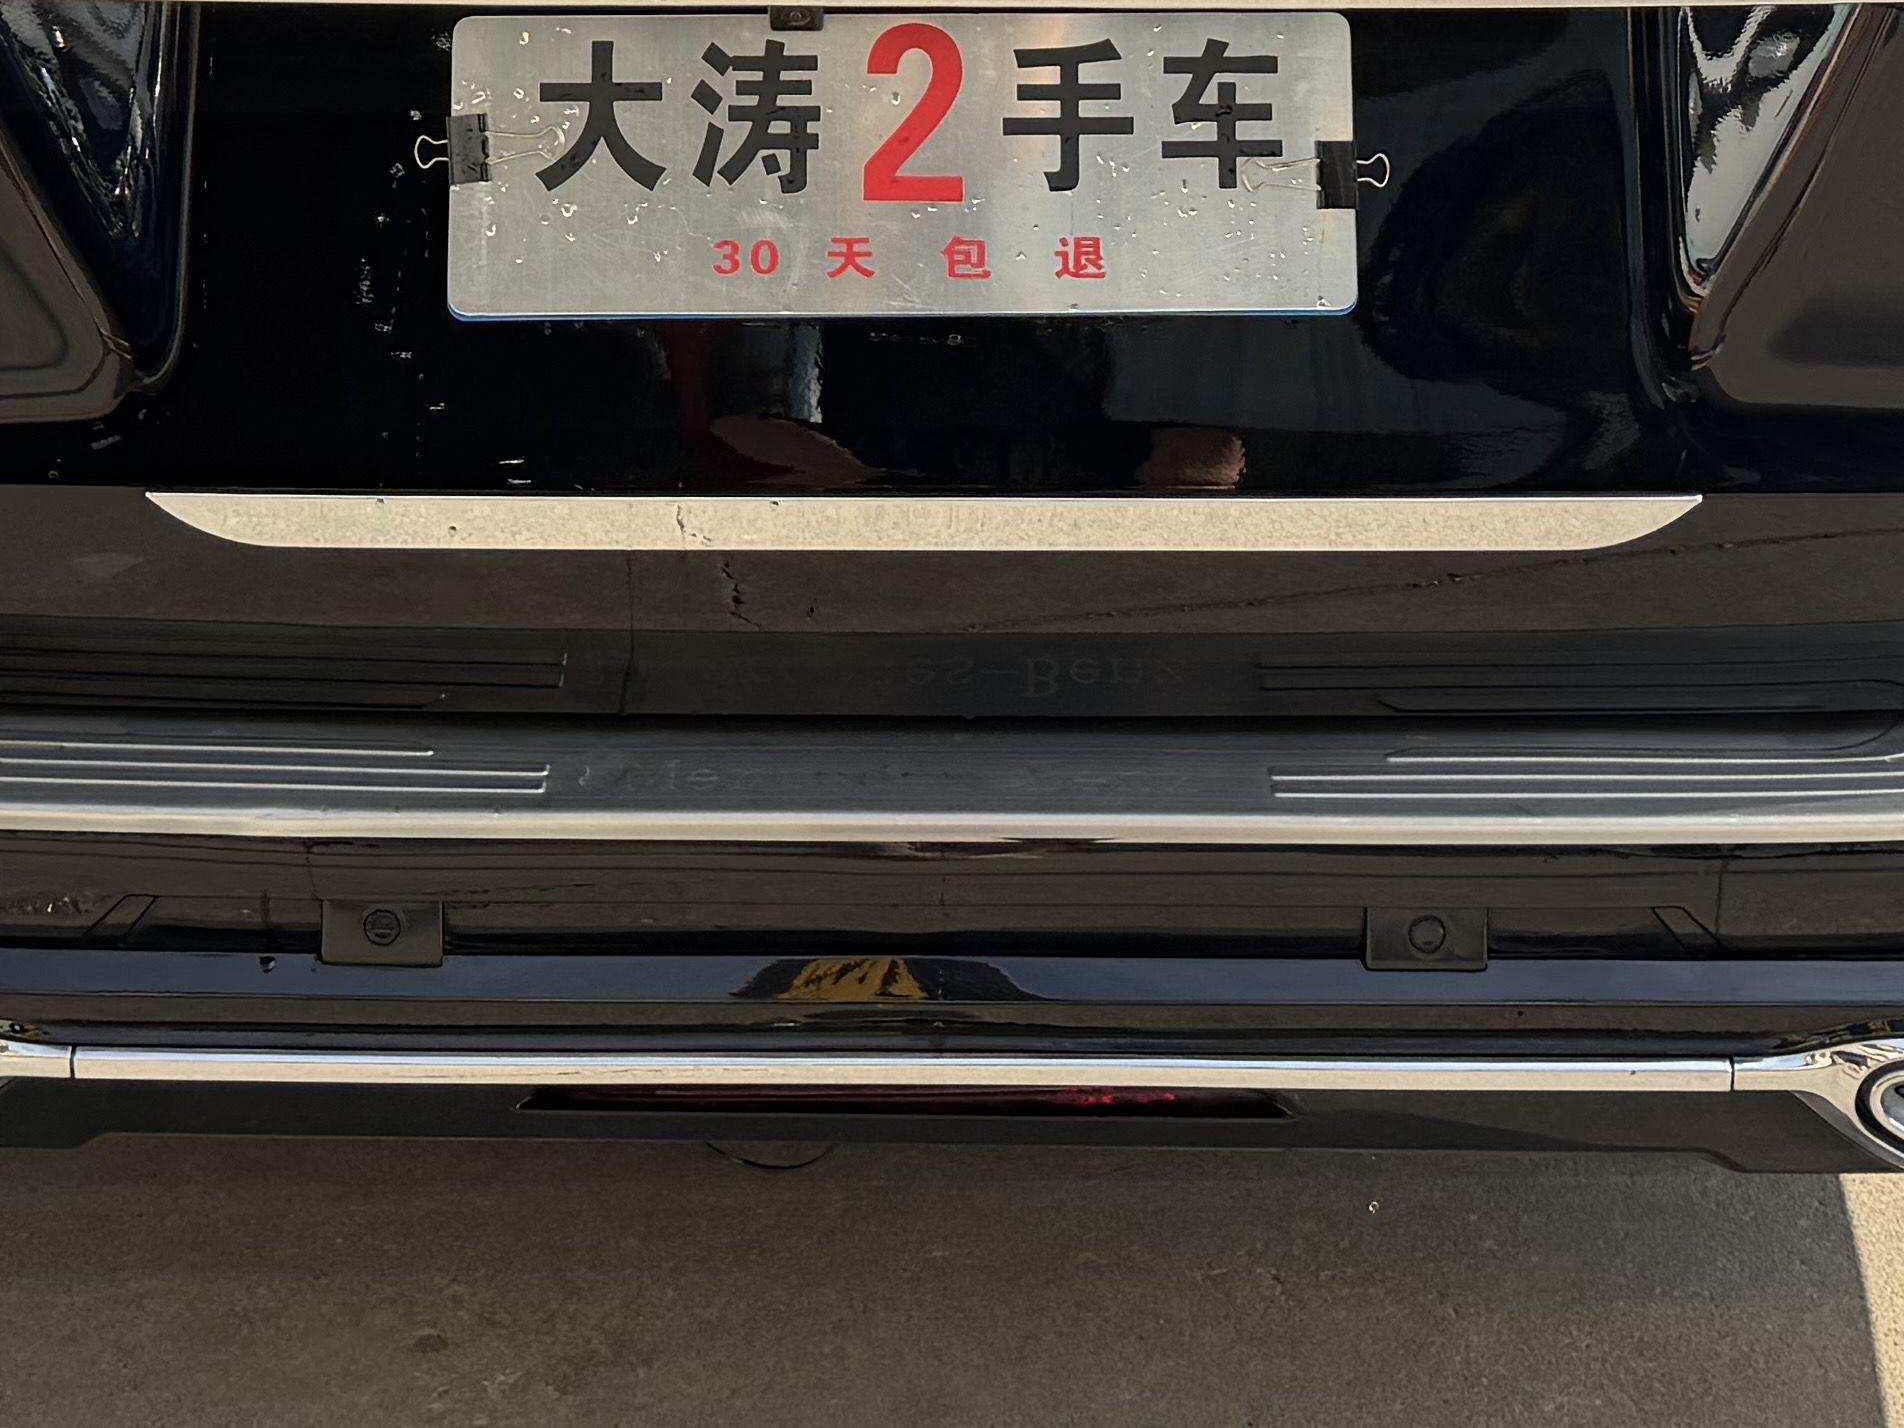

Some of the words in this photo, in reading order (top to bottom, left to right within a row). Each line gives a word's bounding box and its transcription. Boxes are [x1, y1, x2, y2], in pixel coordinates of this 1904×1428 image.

[535, 21, 1284, 204] 大涛2手车
[711, 235, 1107, 280] 30天包退
